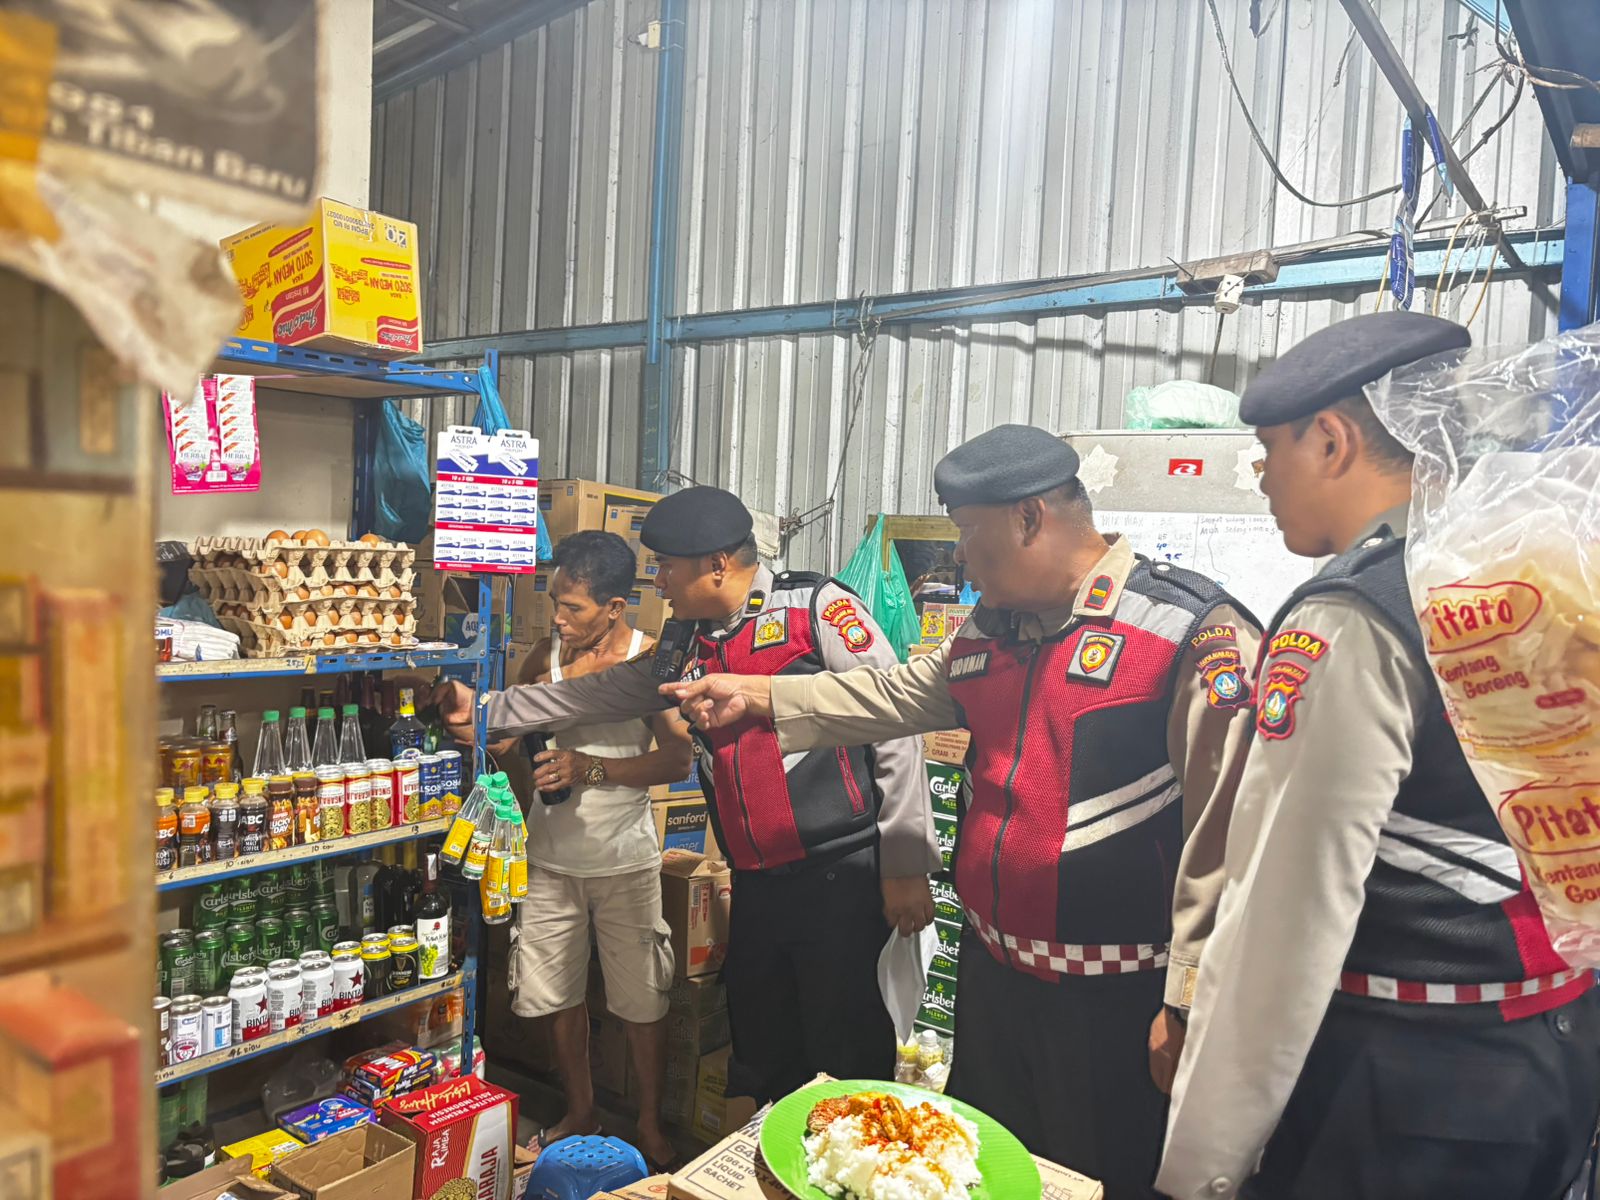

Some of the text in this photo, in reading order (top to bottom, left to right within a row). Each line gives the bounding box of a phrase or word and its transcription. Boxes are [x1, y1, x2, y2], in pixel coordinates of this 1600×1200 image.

[296, 250, 314, 273] SOTO
[273, 258, 296, 285] MEDAN
[370, 277, 413, 294] SOTO MEDAN
[451, 436, 477, 445] ASTRA
[501, 440, 527, 449] ASTRA
[823, 599, 849, 617] POLDA
[1430, 598, 1514, 646] itato
[1190, 627, 1233, 647] POLDA
[1271, 632, 1322, 656] POLDA
[1463, 671, 1530, 699] Goreng
[440, 777, 462, 789] PROS
[929, 776, 960, 795] Carls
[240, 814, 264, 825] ABC
[667, 811, 707, 826] sanford
[1511, 796, 1600, 846] Pitat
[156, 827, 175, 839] BC
[273, 825, 288, 834] DAY
[935, 904, 957, 914] PILSNER
[339, 988, 362, 1000] BINTA
[926, 1009, 947, 1020] PILSNER
[428, 1091, 491, 1119] ASLI INDONESIA
[428, 1092, 506, 1126] KUALITAS PREMIUM
[478, 1145, 499, 1200] ARAJA
[703, 1167, 744, 1191] SACHET
[712, 1160, 745, 1181] LIQUID
